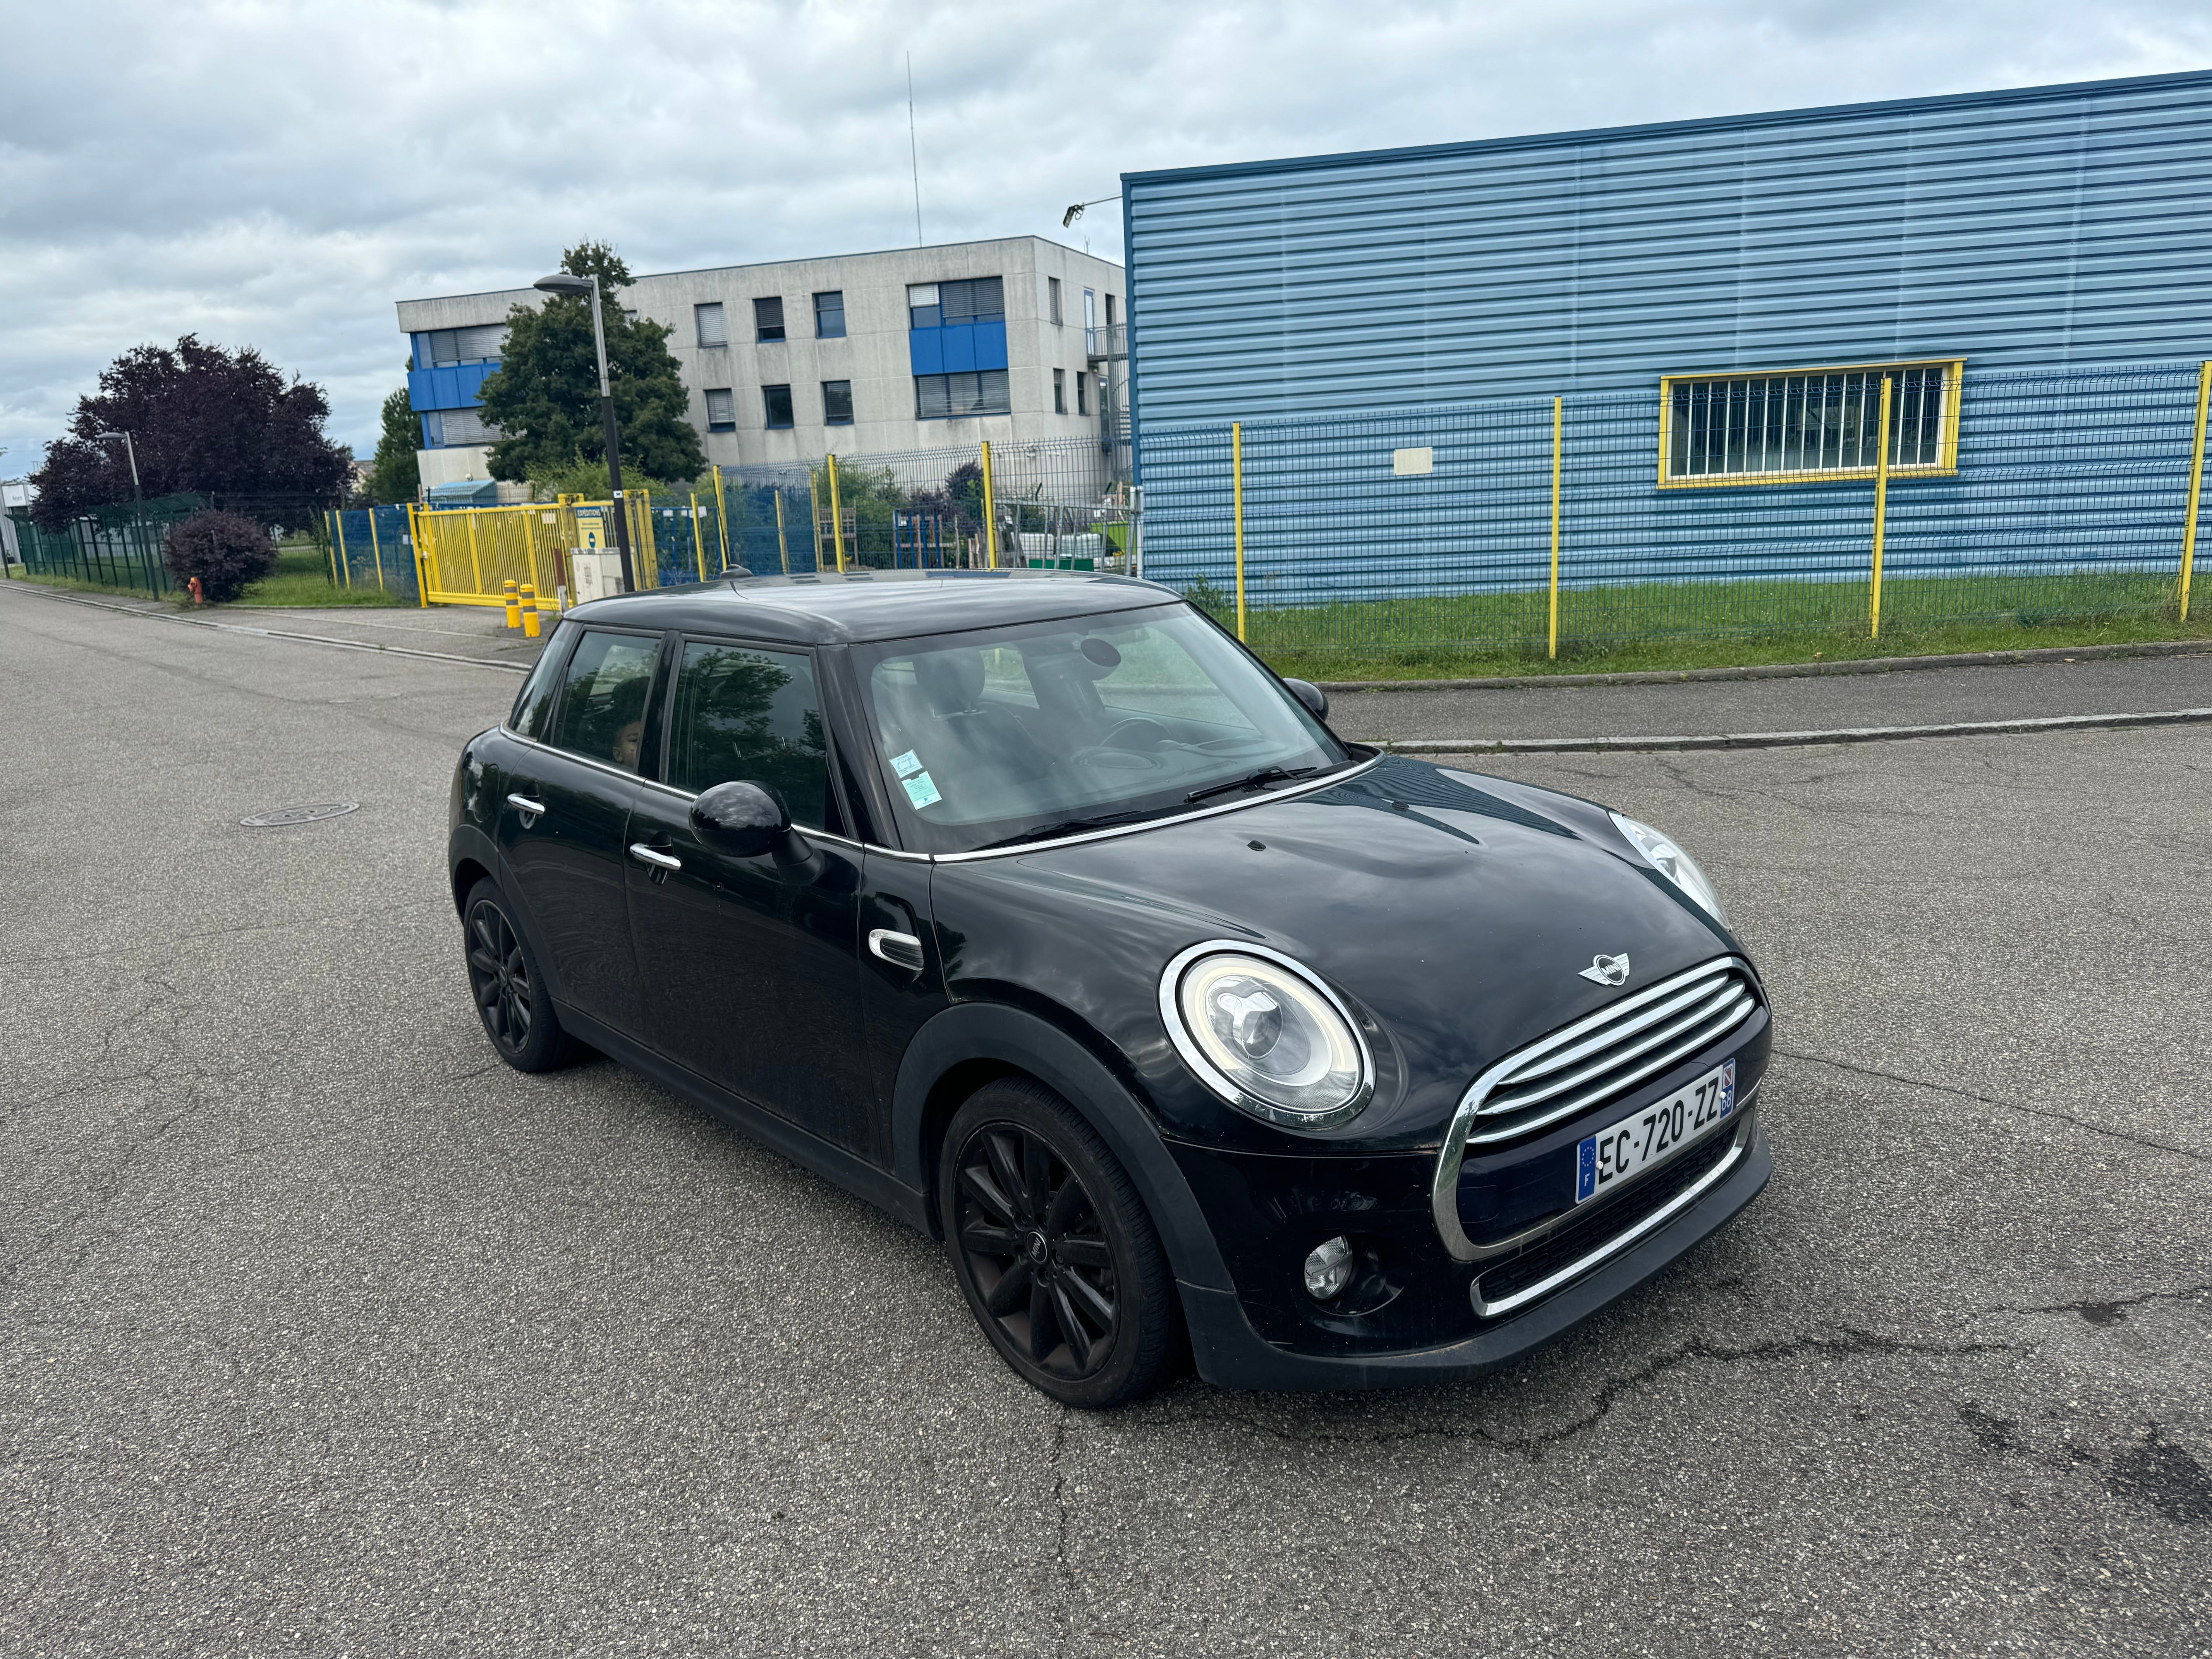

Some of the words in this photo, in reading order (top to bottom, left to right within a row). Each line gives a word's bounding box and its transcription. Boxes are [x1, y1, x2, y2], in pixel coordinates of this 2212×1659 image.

[1601, 963, 1621, 976] MINI
[1722, 1090, 1732, 1111] 68
[1599, 1076, 1719, 1185] EC-720-ZZ
[1584, 1173, 1590, 1187] F
[1032, 1237, 1041, 1257] MINI
